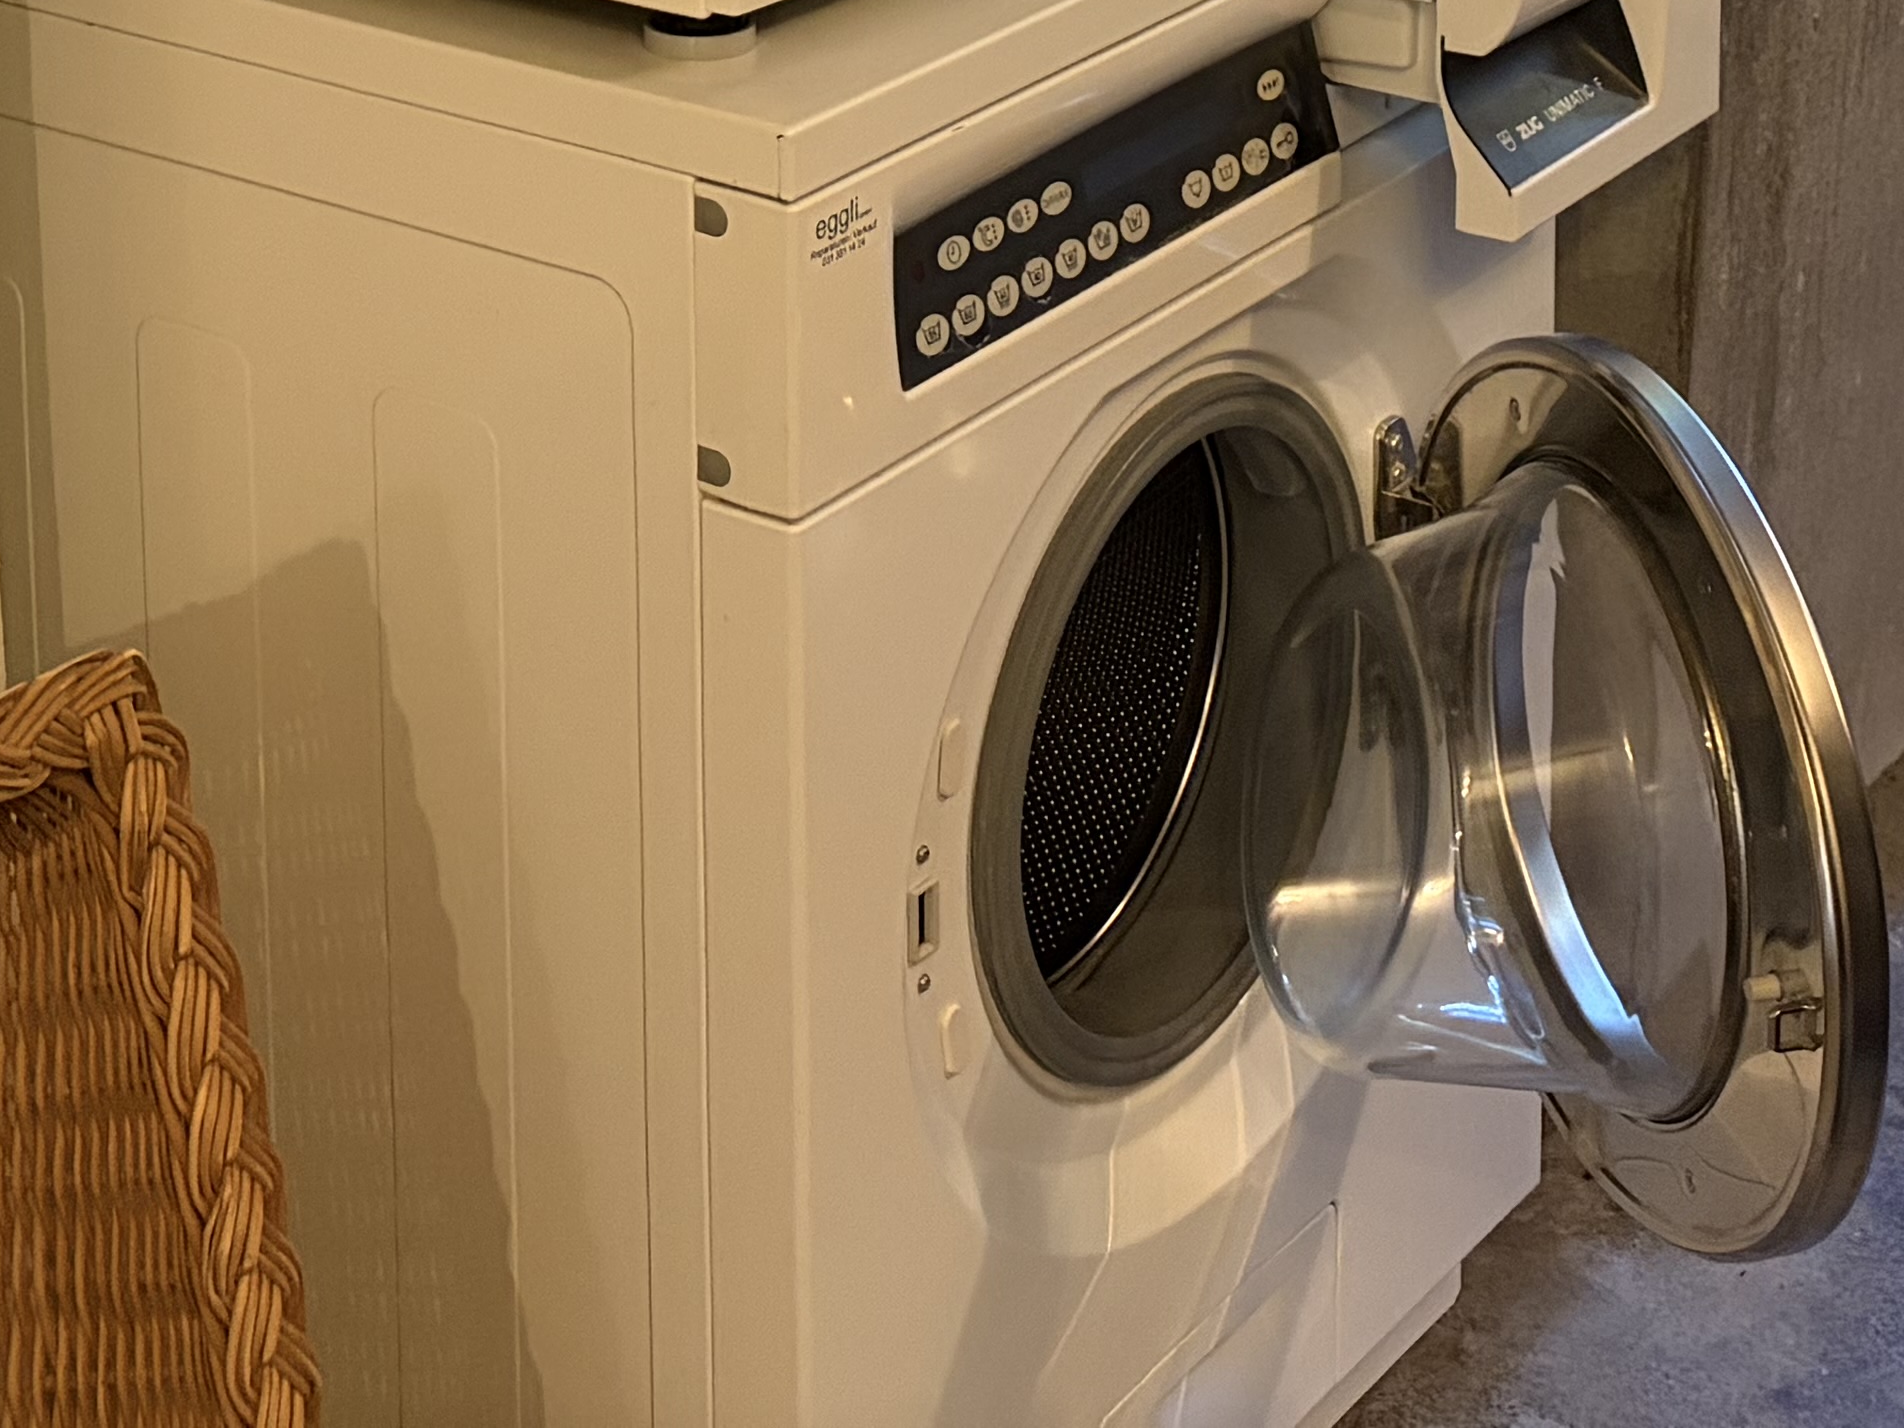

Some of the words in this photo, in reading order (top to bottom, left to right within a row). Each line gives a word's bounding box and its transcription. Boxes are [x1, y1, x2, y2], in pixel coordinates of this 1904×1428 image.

[1516, 116, 1544, 140] ZUG
[1543, 84, 1594, 122] UNIMATIC
[816, 196, 858, 240] eggli
